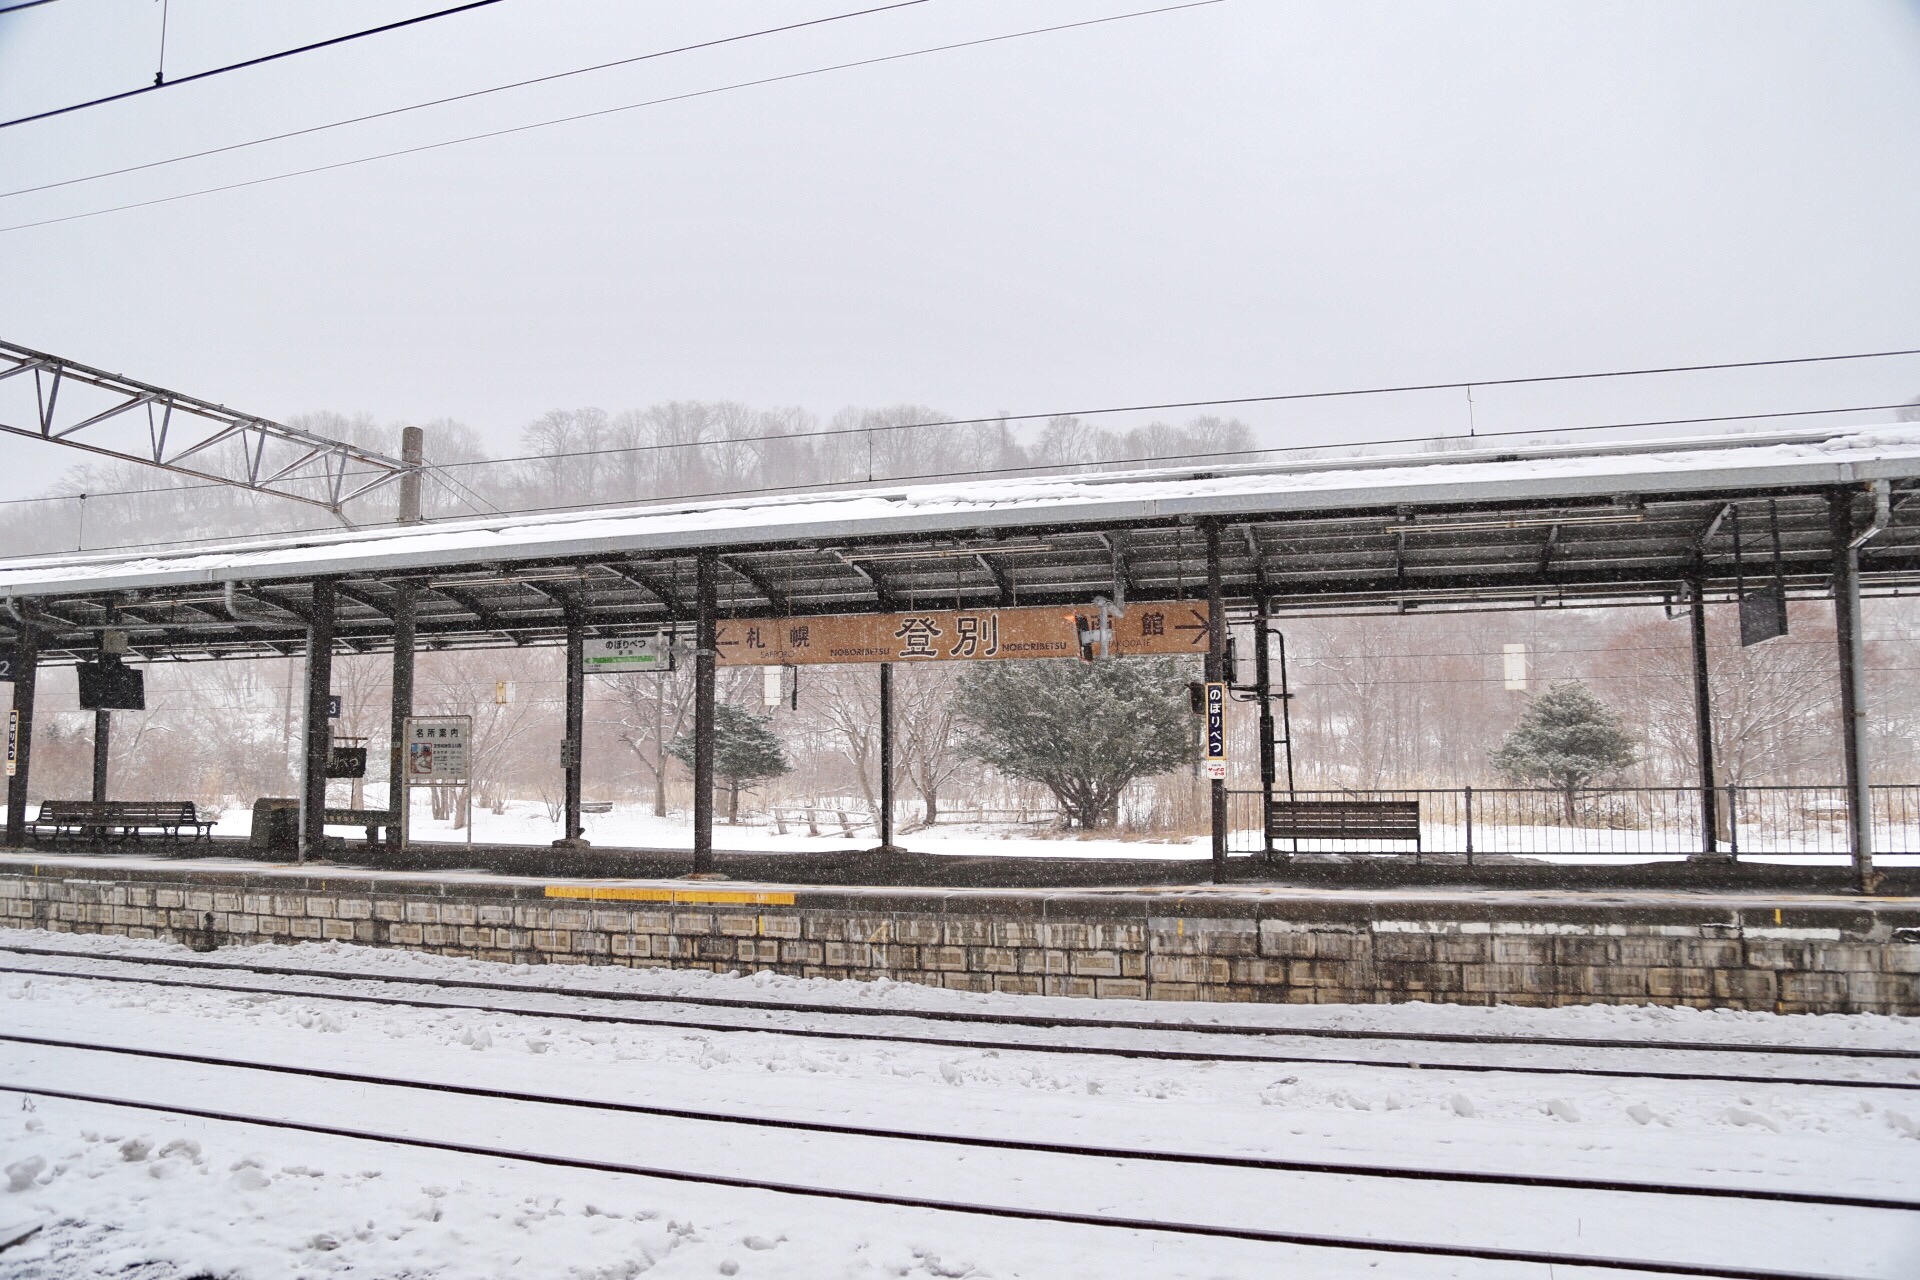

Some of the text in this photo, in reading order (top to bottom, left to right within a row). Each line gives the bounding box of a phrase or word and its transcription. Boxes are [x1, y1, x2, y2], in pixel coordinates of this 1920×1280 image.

[746, 626, 810, 648] 札幌
[894, 614, 999, 657] 登別
[605, 639, 646, 649] のぼりべつ
[1002, 642, 1067, 651] NOBORIBETSU
[760, 651, 795, 659] SAPPORO
[830, 648, 890, 656] NOBORIBETSU
[0, 661, 10, 676] 2
[329, 702, 336, 714] 3
[1209, 689, 1222, 753] のぼりべつ
[8, 714, 17, 758] のぼりべつ
[416, 728, 459, 738] 名所案内
